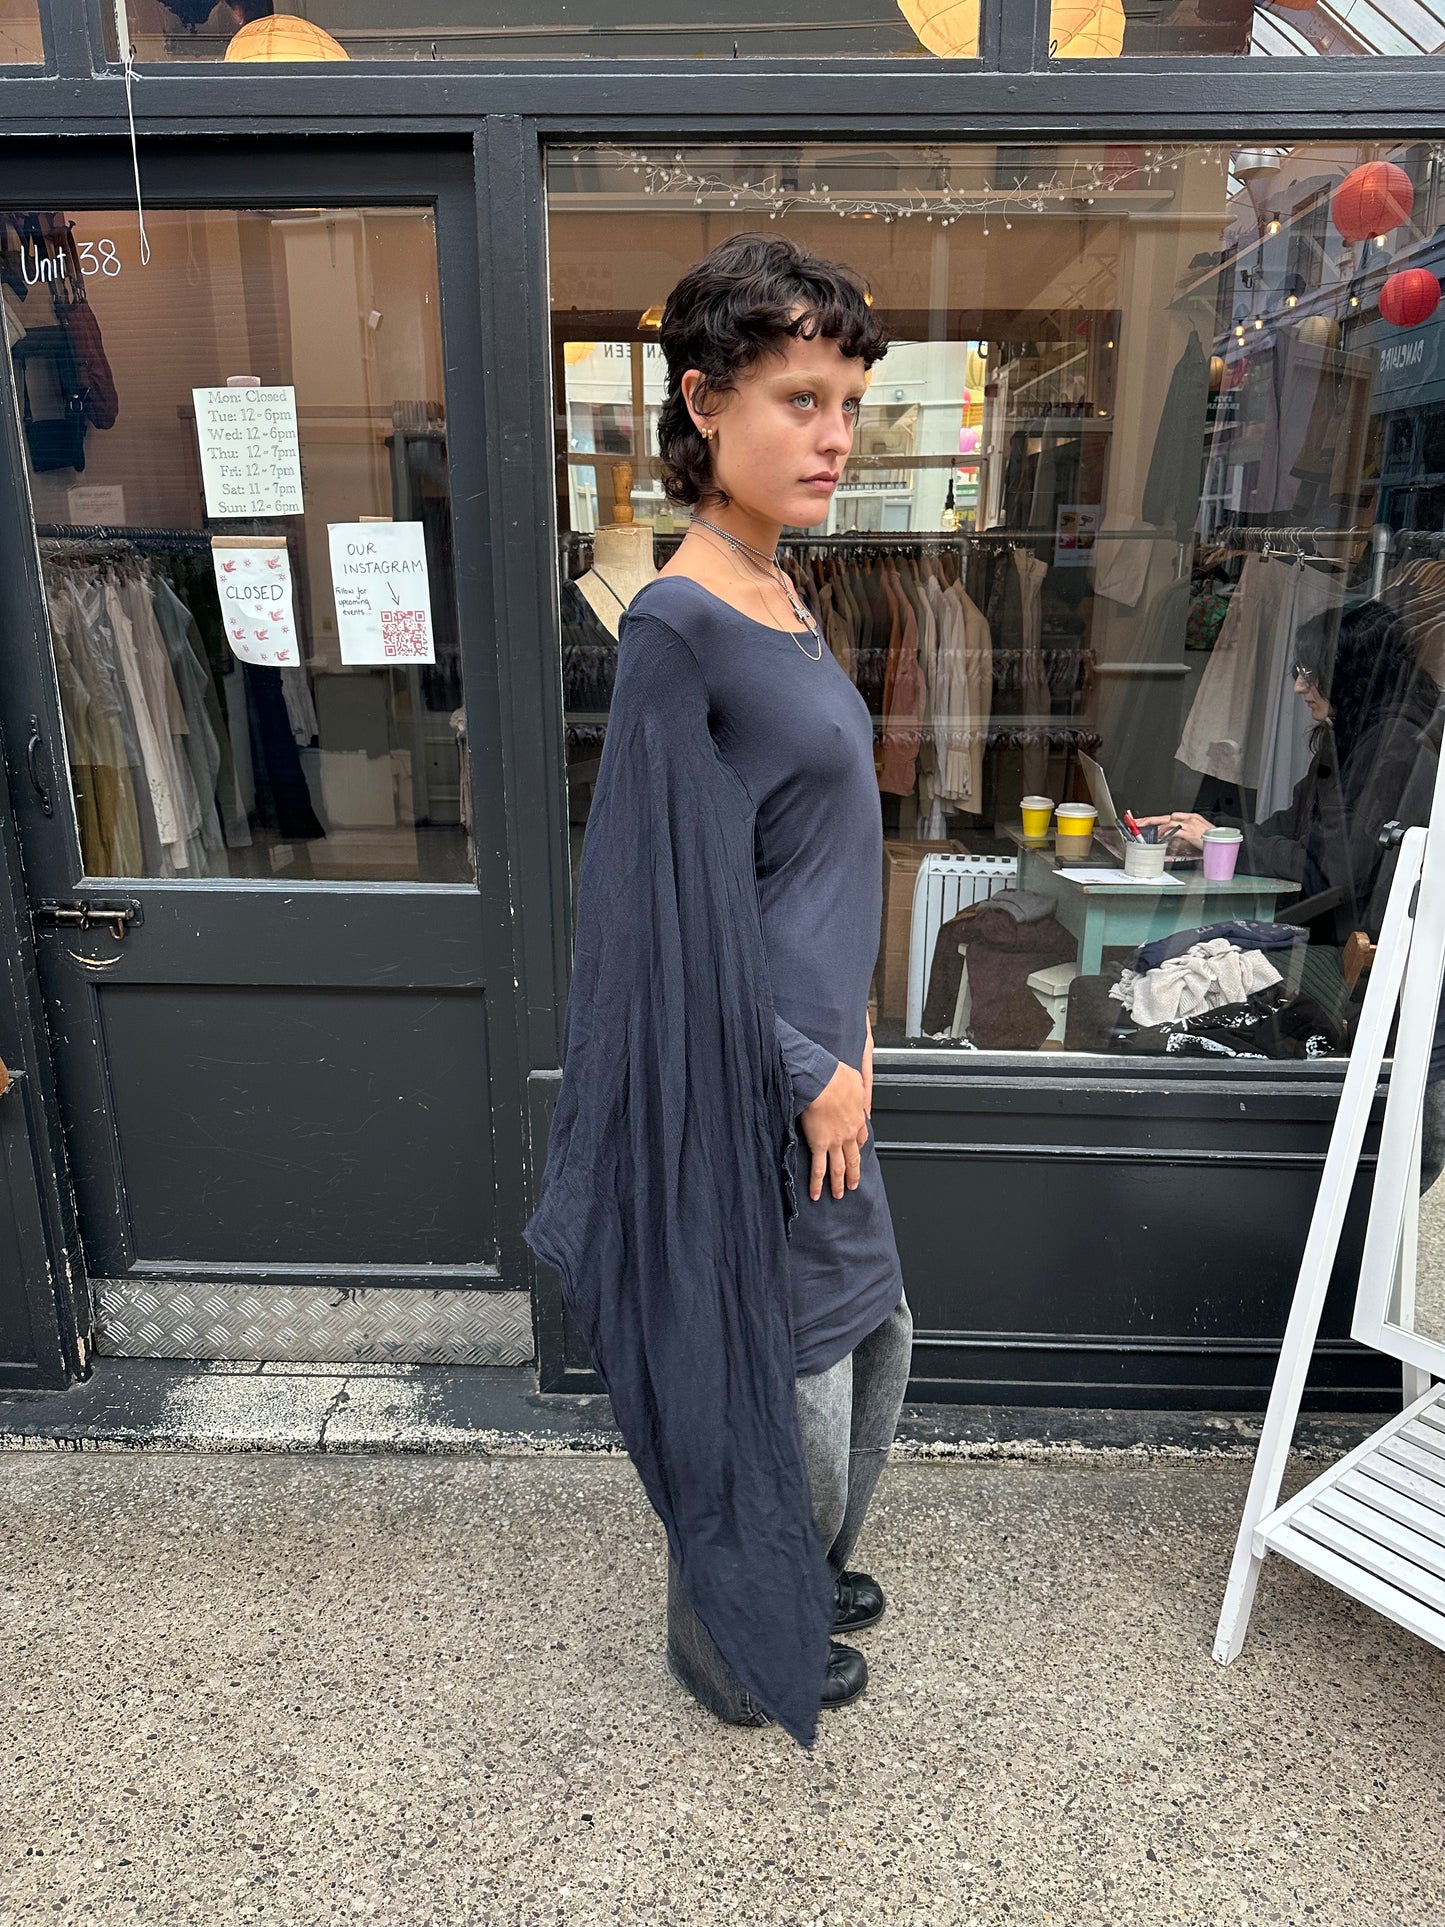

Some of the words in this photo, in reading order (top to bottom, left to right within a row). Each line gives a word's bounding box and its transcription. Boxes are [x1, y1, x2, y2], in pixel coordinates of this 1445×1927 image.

[21, 244, 66, 285] Unit
[77, 239, 121, 277] 38
[208, 391, 241, 403] Mon:
[245, 390, 287, 402] Closed
[208, 410, 237, 422] Tue:
[208, 428, 243, 440] Wed:
[207, 447, 239, 459] Thu:
[220, 465, 242, 477] Fri:
[222, 483, 245, 495] Sat:
[218, 501, 247, 513] Sun:
[347, 542, 377, 556] OUR
[343, 560, 424, 574] INSTAGRAM
[226, 584, 284, 601] CLOSED
[356, 586, 368, 600] for
[338, 599, 372, 610] upcoming
